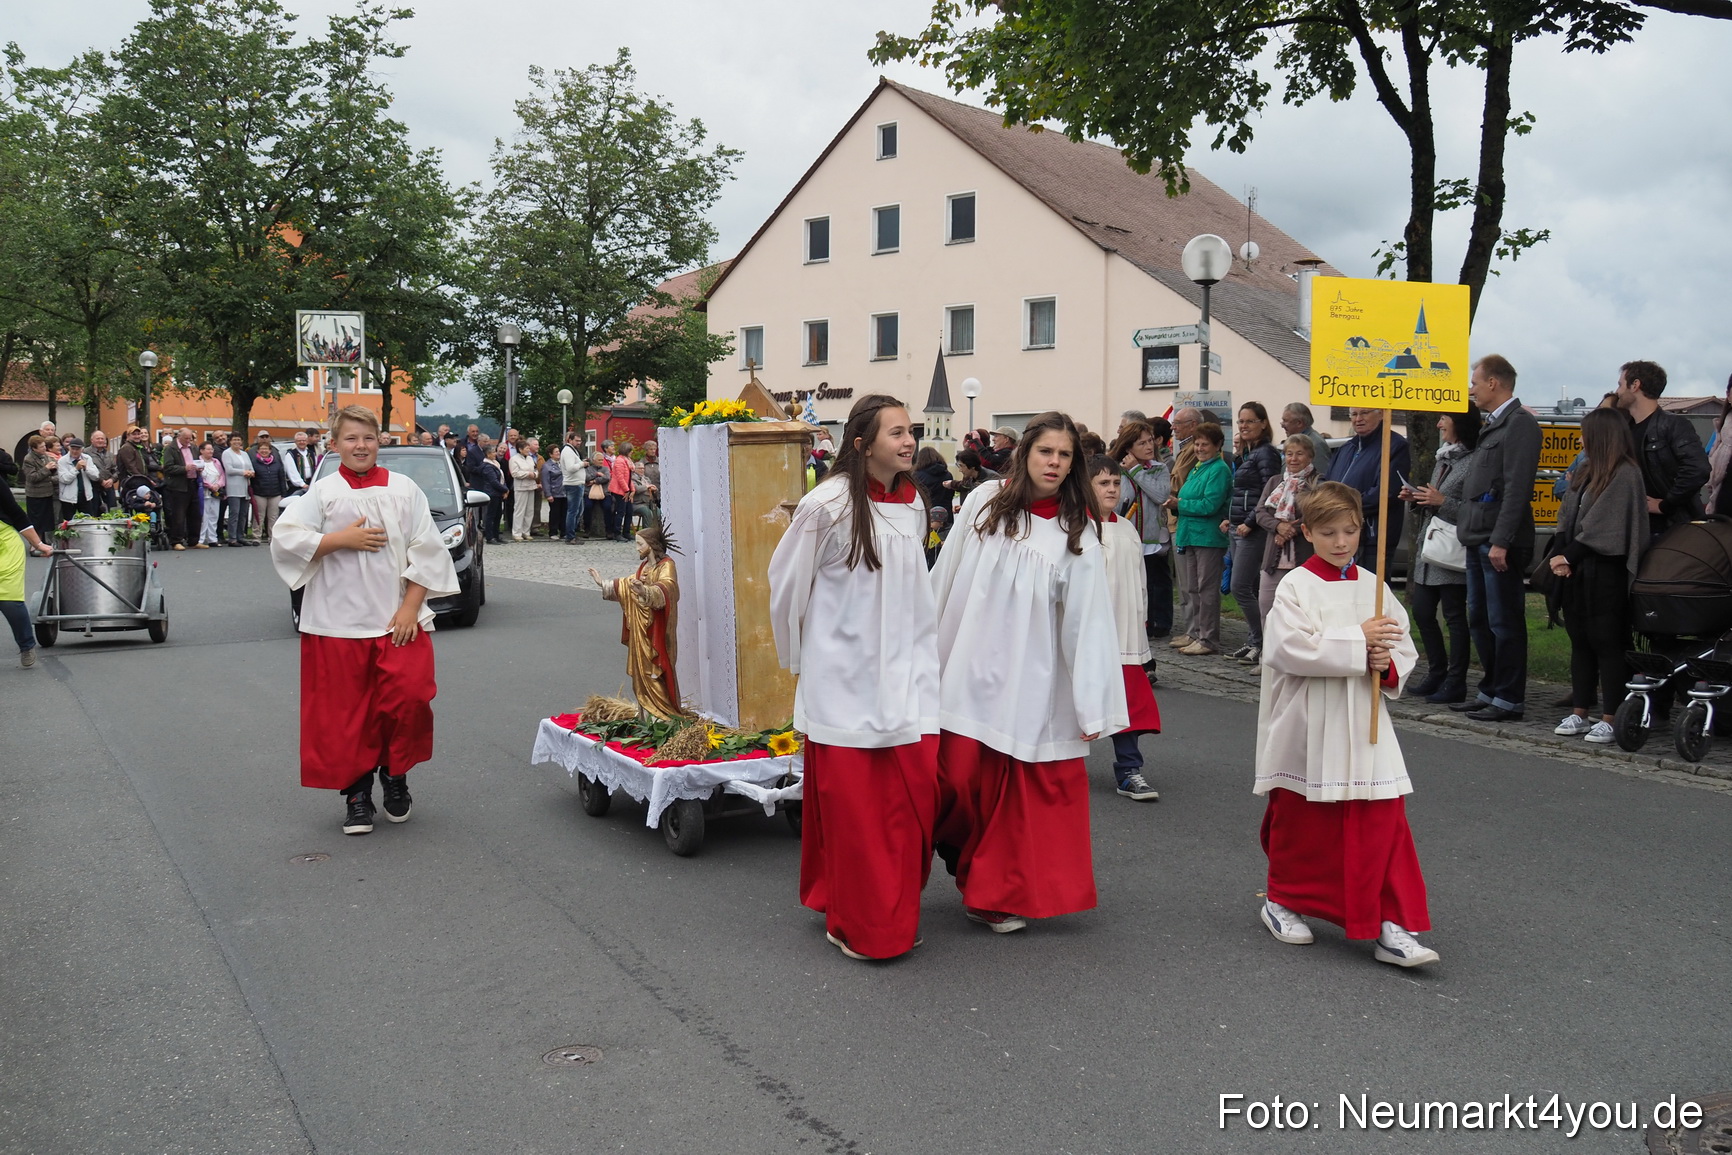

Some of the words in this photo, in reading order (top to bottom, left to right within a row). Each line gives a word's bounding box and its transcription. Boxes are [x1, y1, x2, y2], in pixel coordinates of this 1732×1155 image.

[1330, 311, 1360, 321] Berngau
[1345, 305, 1364, 314] Jahre
[816, 382, 853, 400] Sonne
[1318, 375, 1386, 398] Pfarrei
[1391, 378, 1462, 405] Berngau
